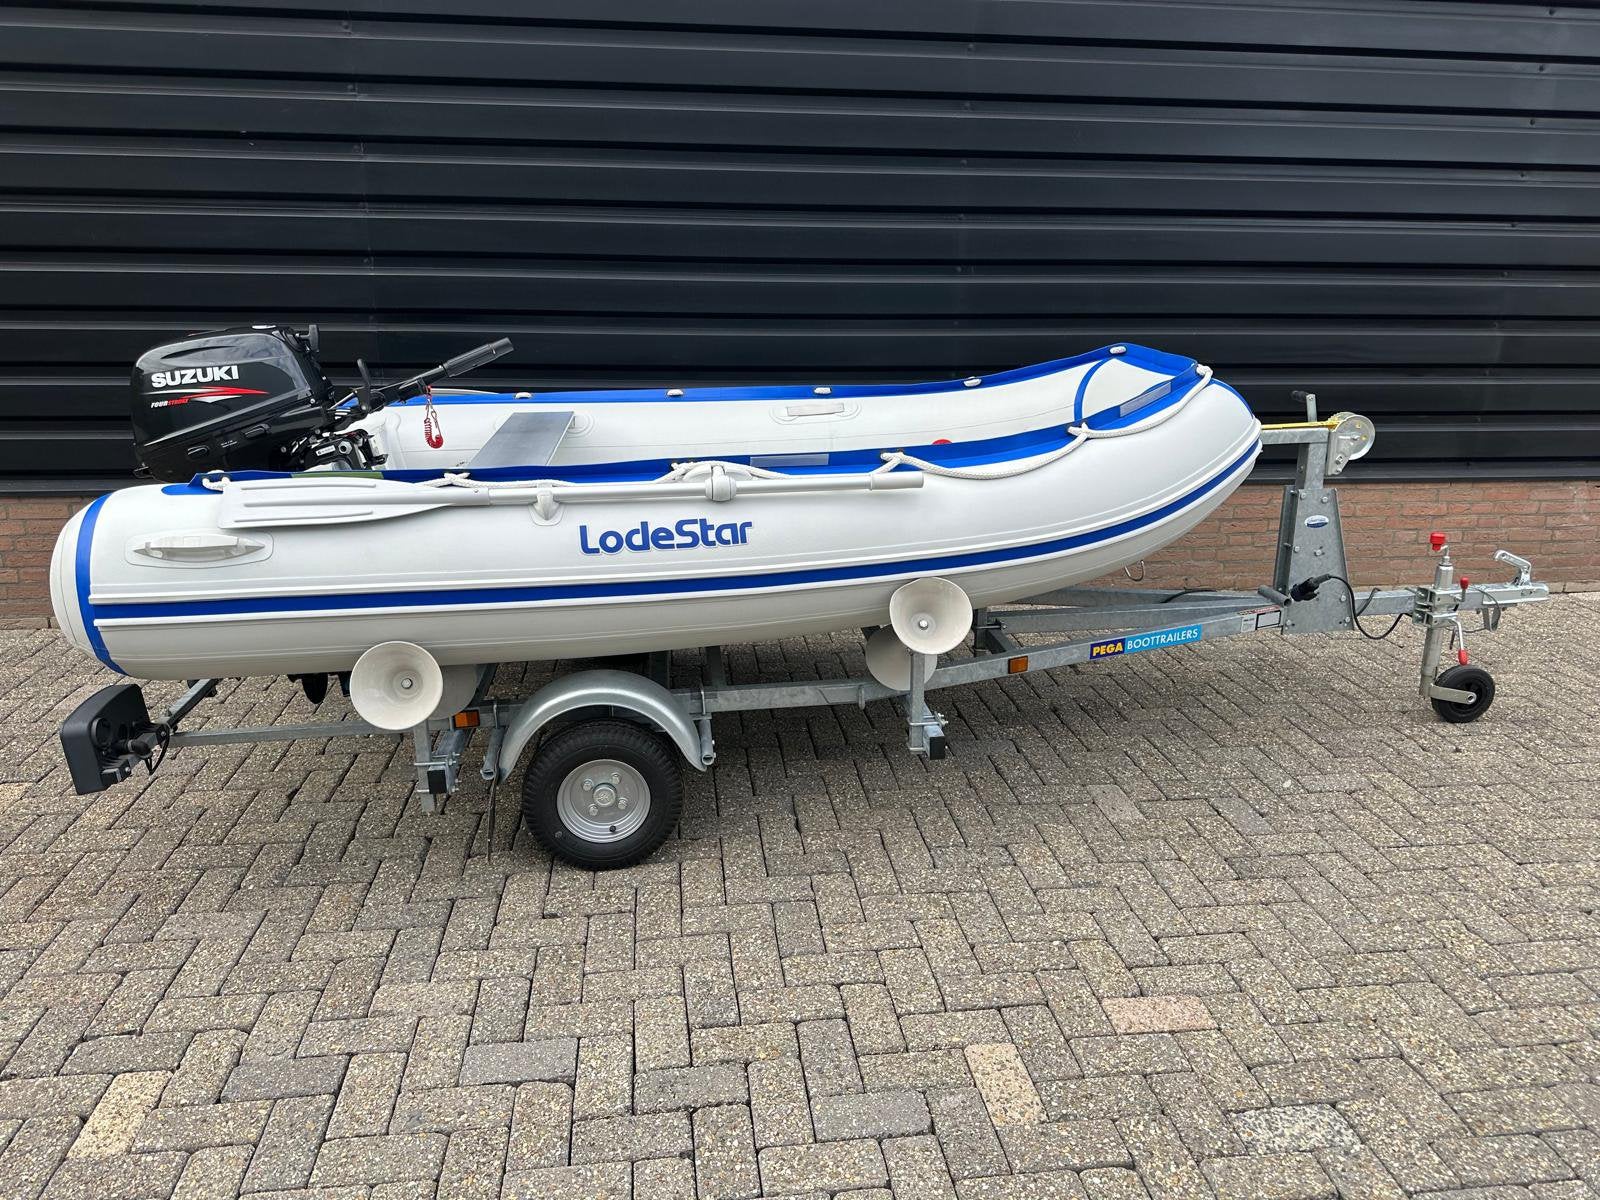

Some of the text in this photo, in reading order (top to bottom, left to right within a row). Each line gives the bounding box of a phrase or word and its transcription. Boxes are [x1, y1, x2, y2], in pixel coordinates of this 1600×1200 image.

[151, 365, 239, 388] SUZUKI
[579, 518, 753, 554] LodeStar
[1092, 628, 1198, 656] PEGA BOOTTRAILERS
